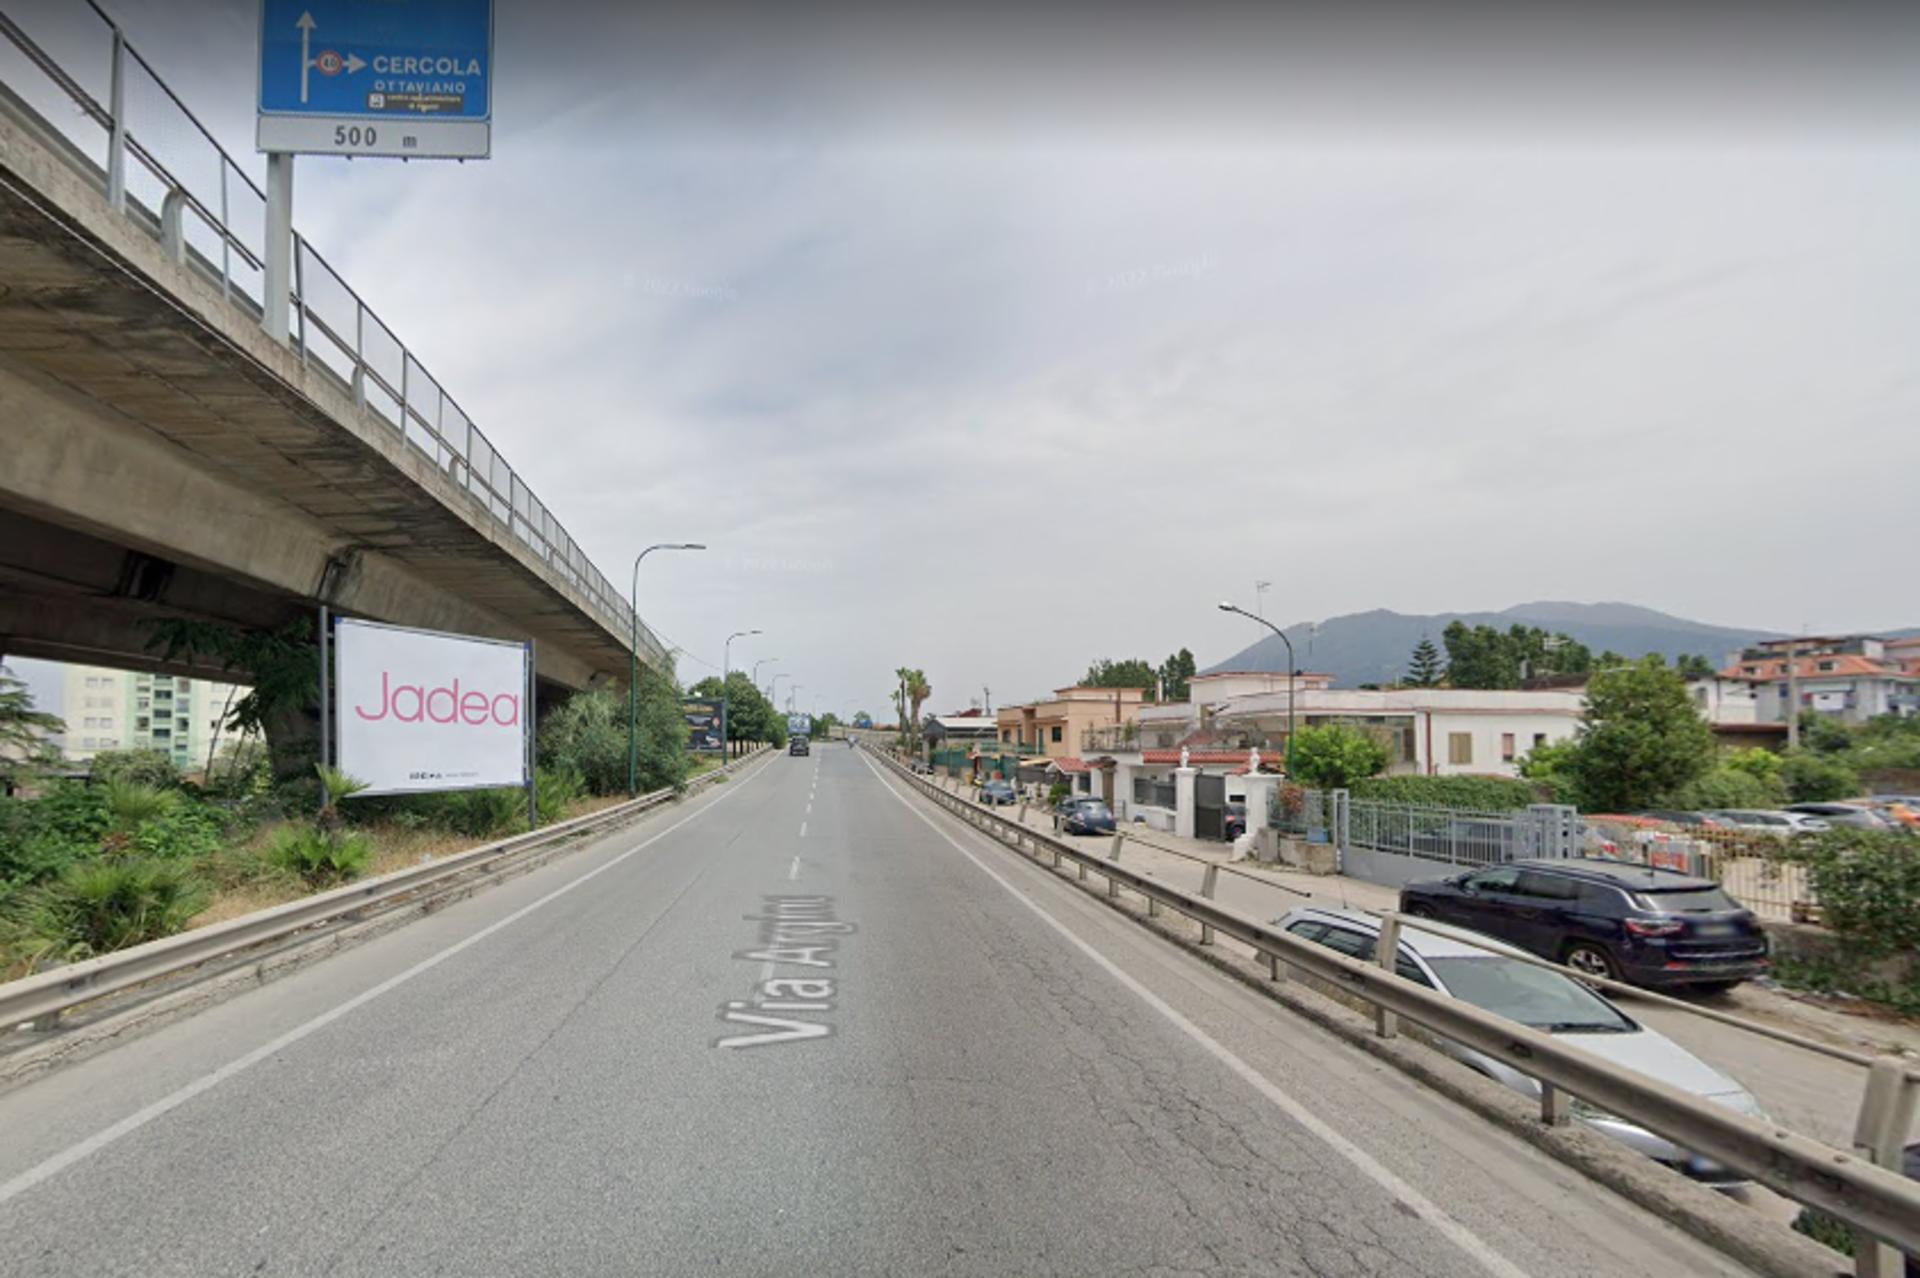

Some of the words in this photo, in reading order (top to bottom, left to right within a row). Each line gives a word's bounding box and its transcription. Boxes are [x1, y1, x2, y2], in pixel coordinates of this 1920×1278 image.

[372, 55, 482, 76] CERCOLA
[374, 79, 467, 93] OTTAVIANO
[334, 125, 377, 147] 500
[402, 135, 417, 148] m
[354, 671, 519, 727] Jadea
